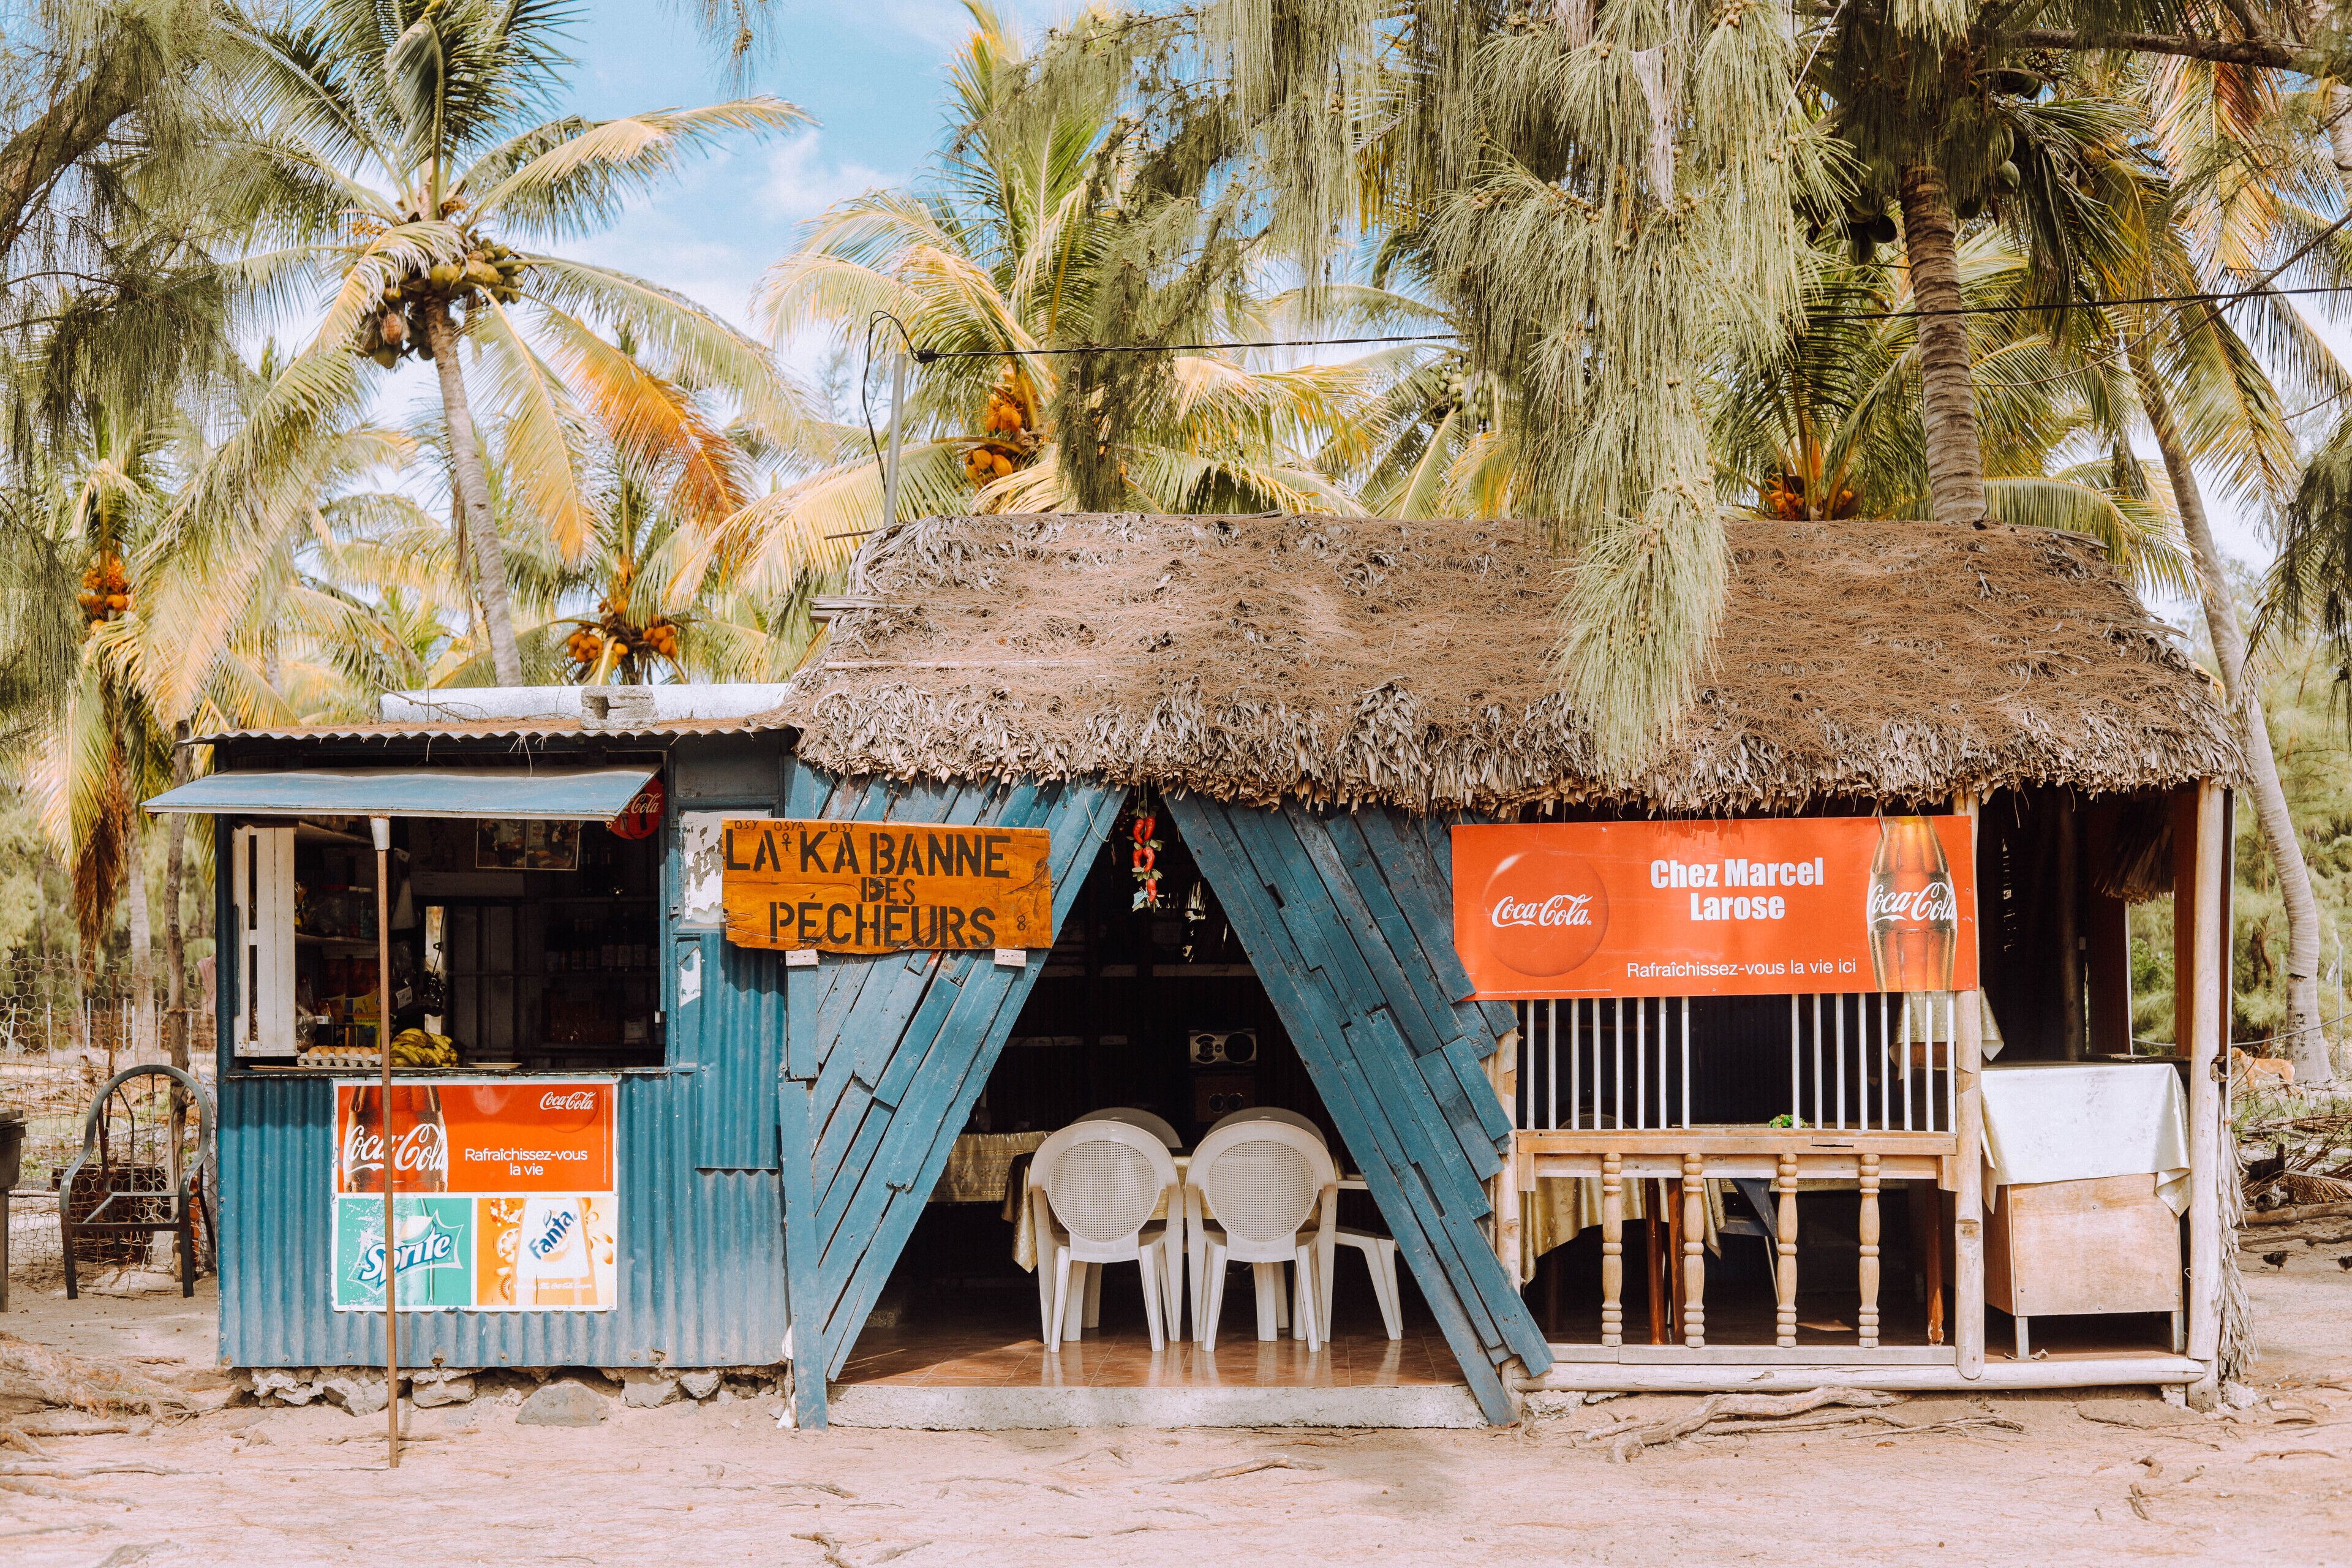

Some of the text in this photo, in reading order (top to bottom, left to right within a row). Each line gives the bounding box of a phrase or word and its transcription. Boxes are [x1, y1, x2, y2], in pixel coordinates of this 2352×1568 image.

[726, 829, 1010, 878] LA KABANNE
[1651, 858, 1823, 888] Chez Marcel
[861, 876, 916, 905] DES
[1869, 882, 1956, 924] Coca-Cola
[1491, 894, 1593, 927] Coca-Cola
[1690, 892, 1785, 921] Larose
[1627, 958, 1856, 978] Rafraîchissez-vous la vie ici
[540, 1091, 597, 1110] Coca-Cola
[465, 1147, 588, 1161] Rafraîchissez-vous
[510, 1162, 544, 1176] la vie
[528, 1211, 575, 1260] Fanta
